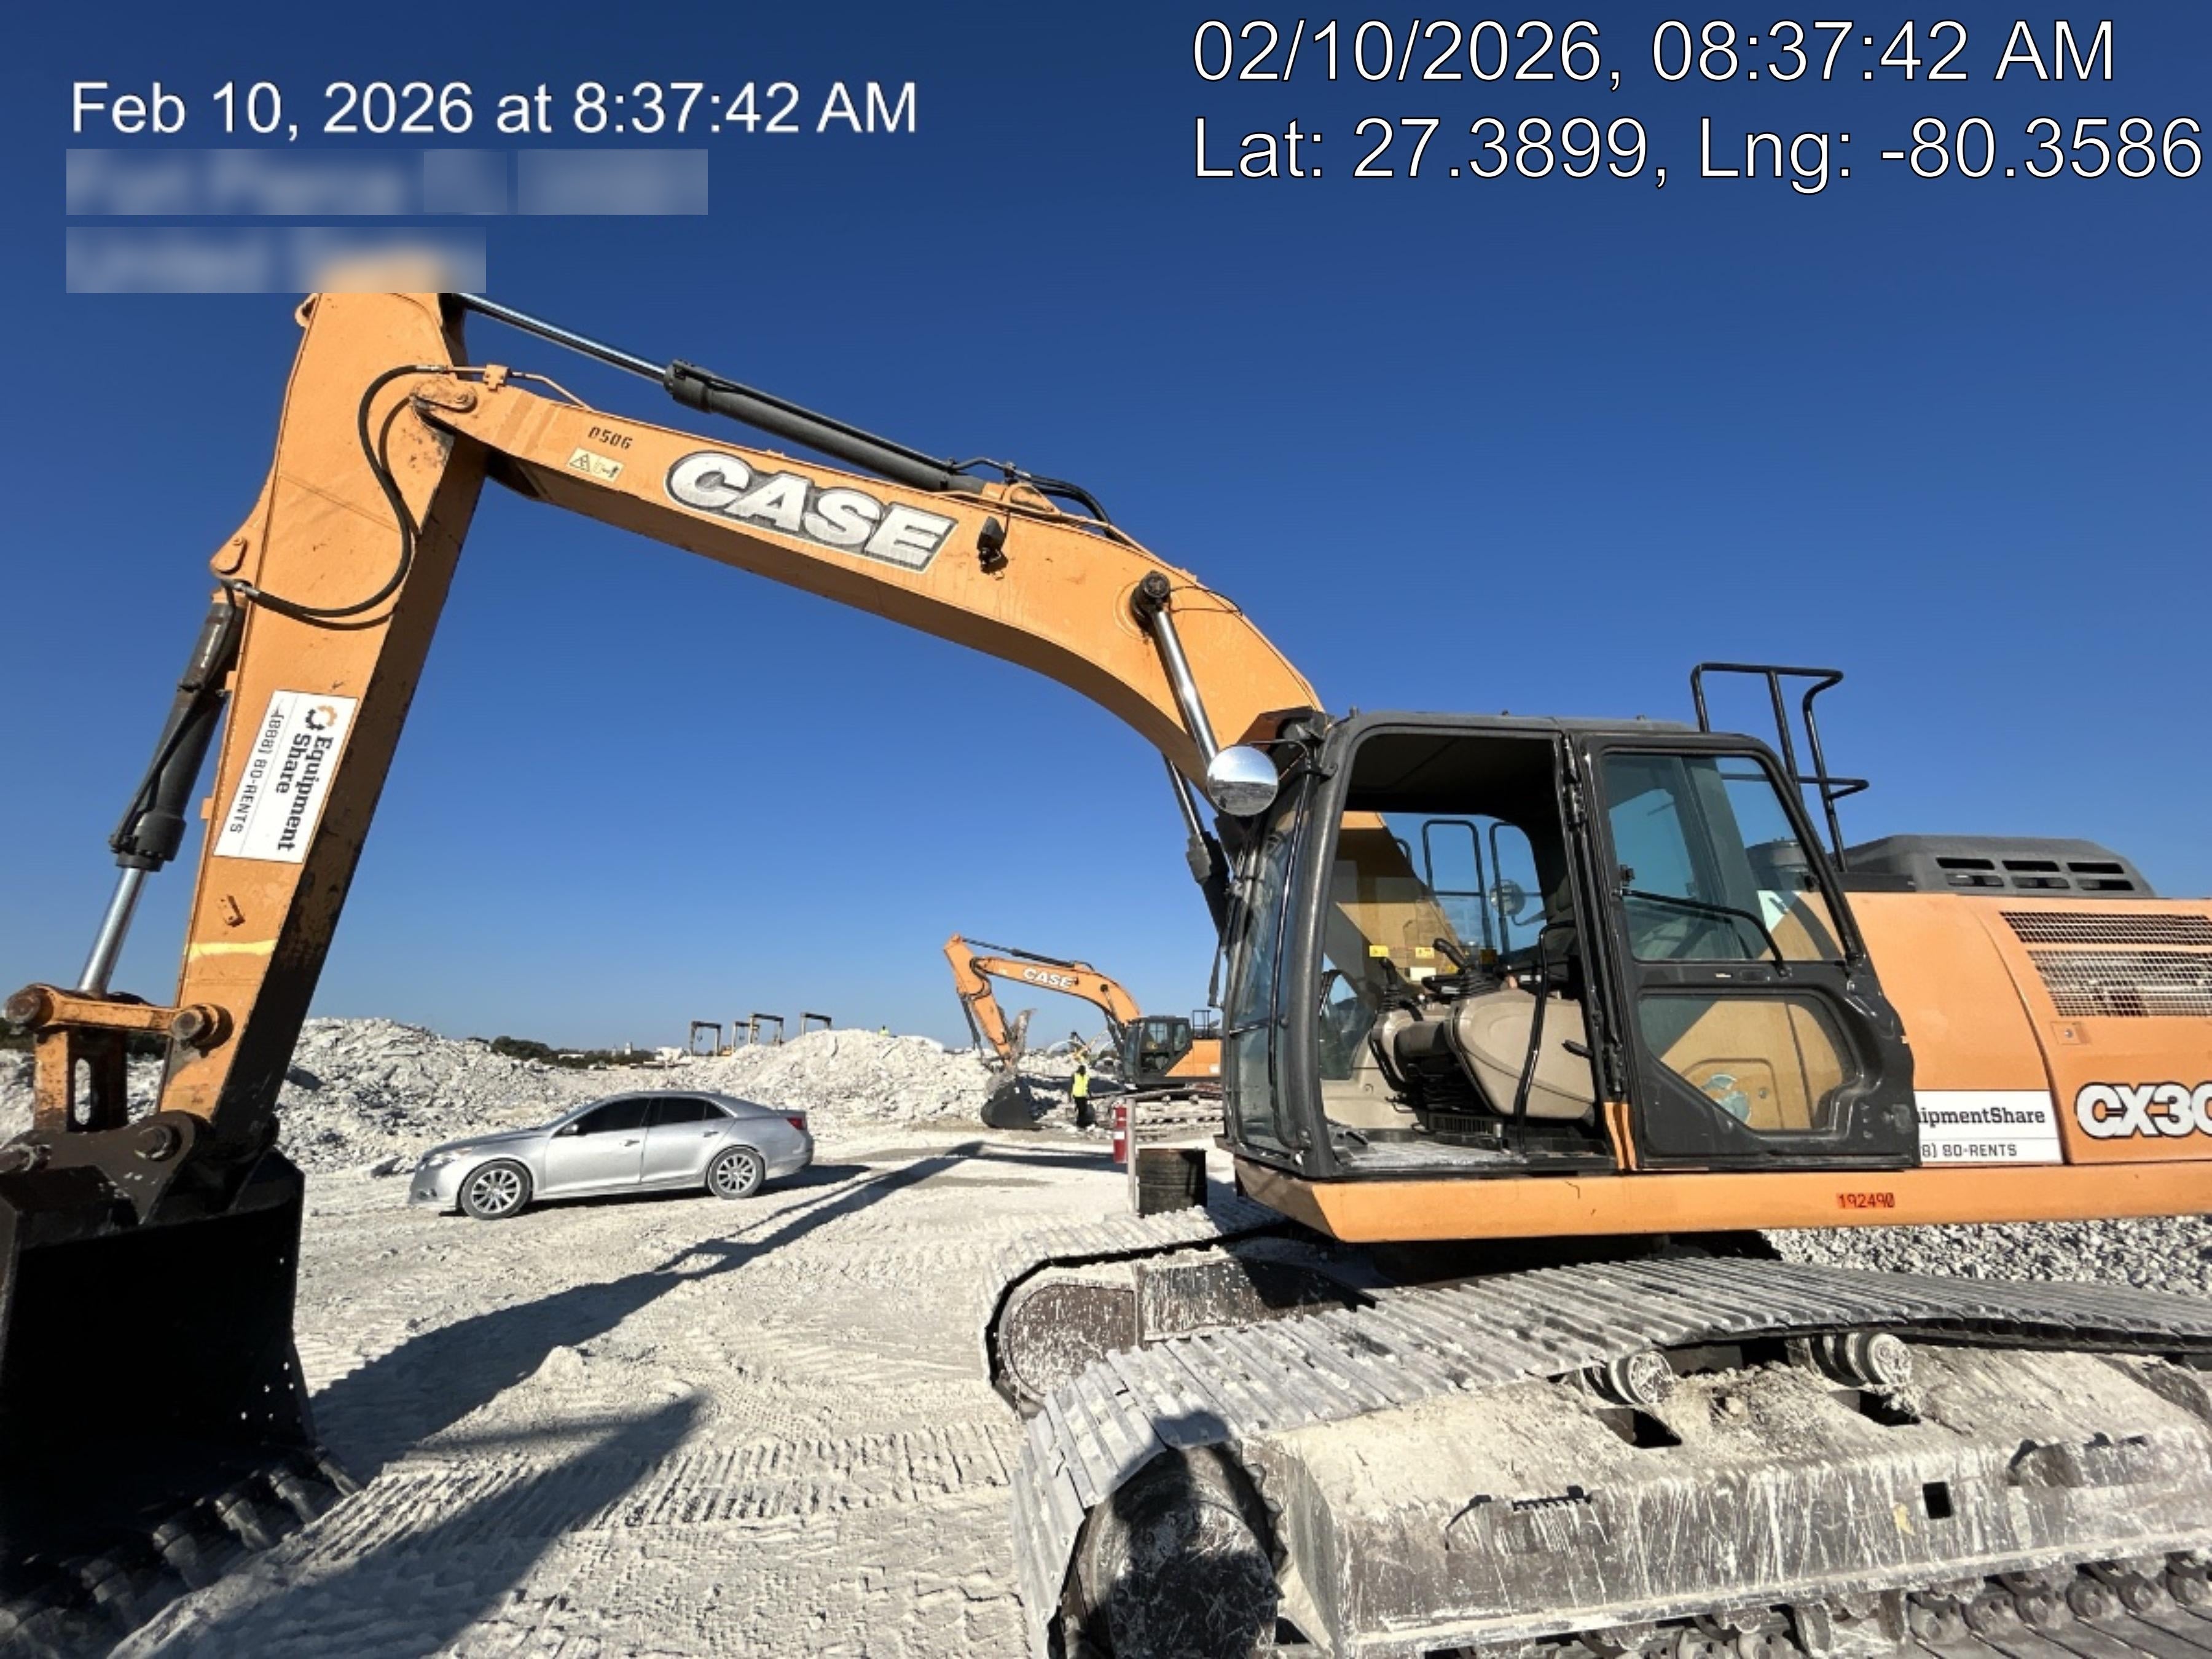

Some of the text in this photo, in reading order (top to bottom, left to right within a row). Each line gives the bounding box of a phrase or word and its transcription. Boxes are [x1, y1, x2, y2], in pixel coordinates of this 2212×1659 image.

[665, 450, 958, 571] CASE
[276, 733, 312, 794] Share
[277, 736, 334, 851] Equipment
[1022, 967, 1073, 989] CASE
[1838, 1193, 1895, 1209] 192490
